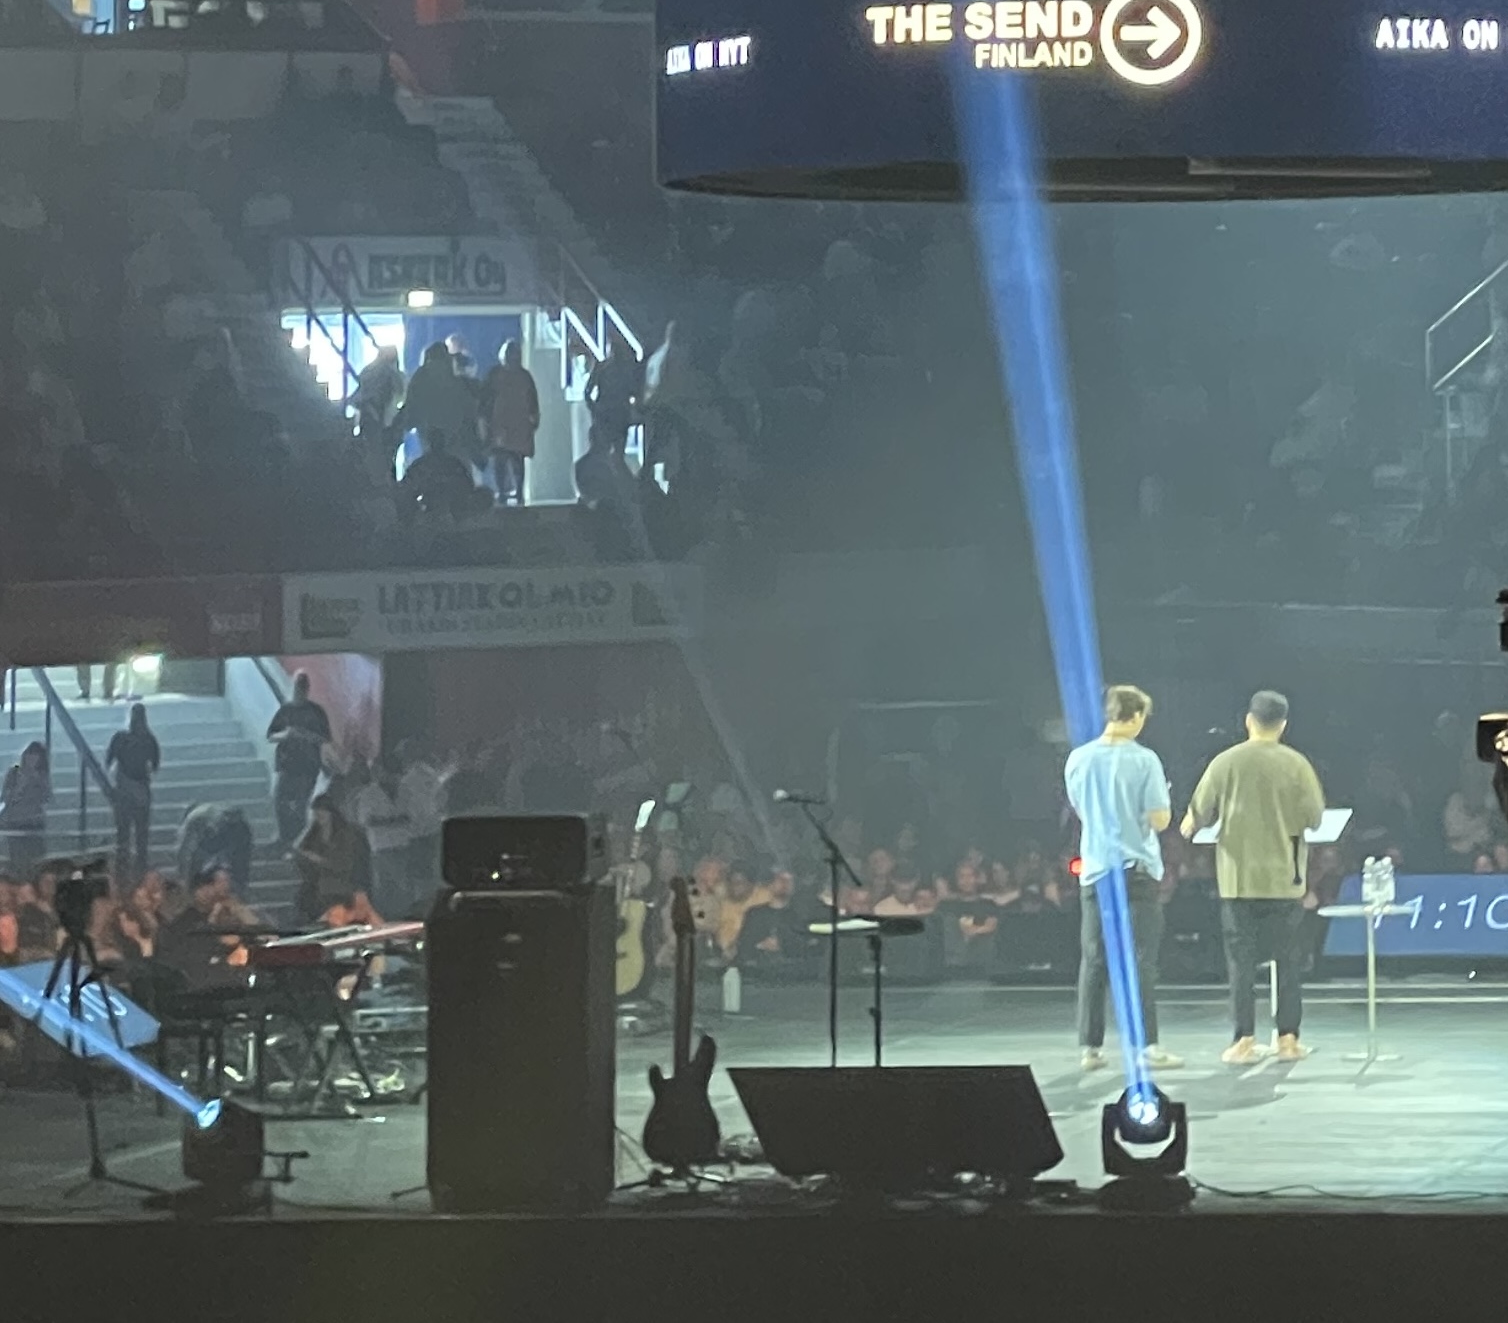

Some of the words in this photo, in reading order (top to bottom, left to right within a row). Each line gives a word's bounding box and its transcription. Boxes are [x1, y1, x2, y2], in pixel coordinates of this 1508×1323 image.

[865, 3, 953, 45] THE
[963, 0, 1093, 41] SEND
[1375, 17, 1450, 50] AIKA
[1462, 18, 1499, 51] ON
[974, 41, 1093, 69] FINLAND
